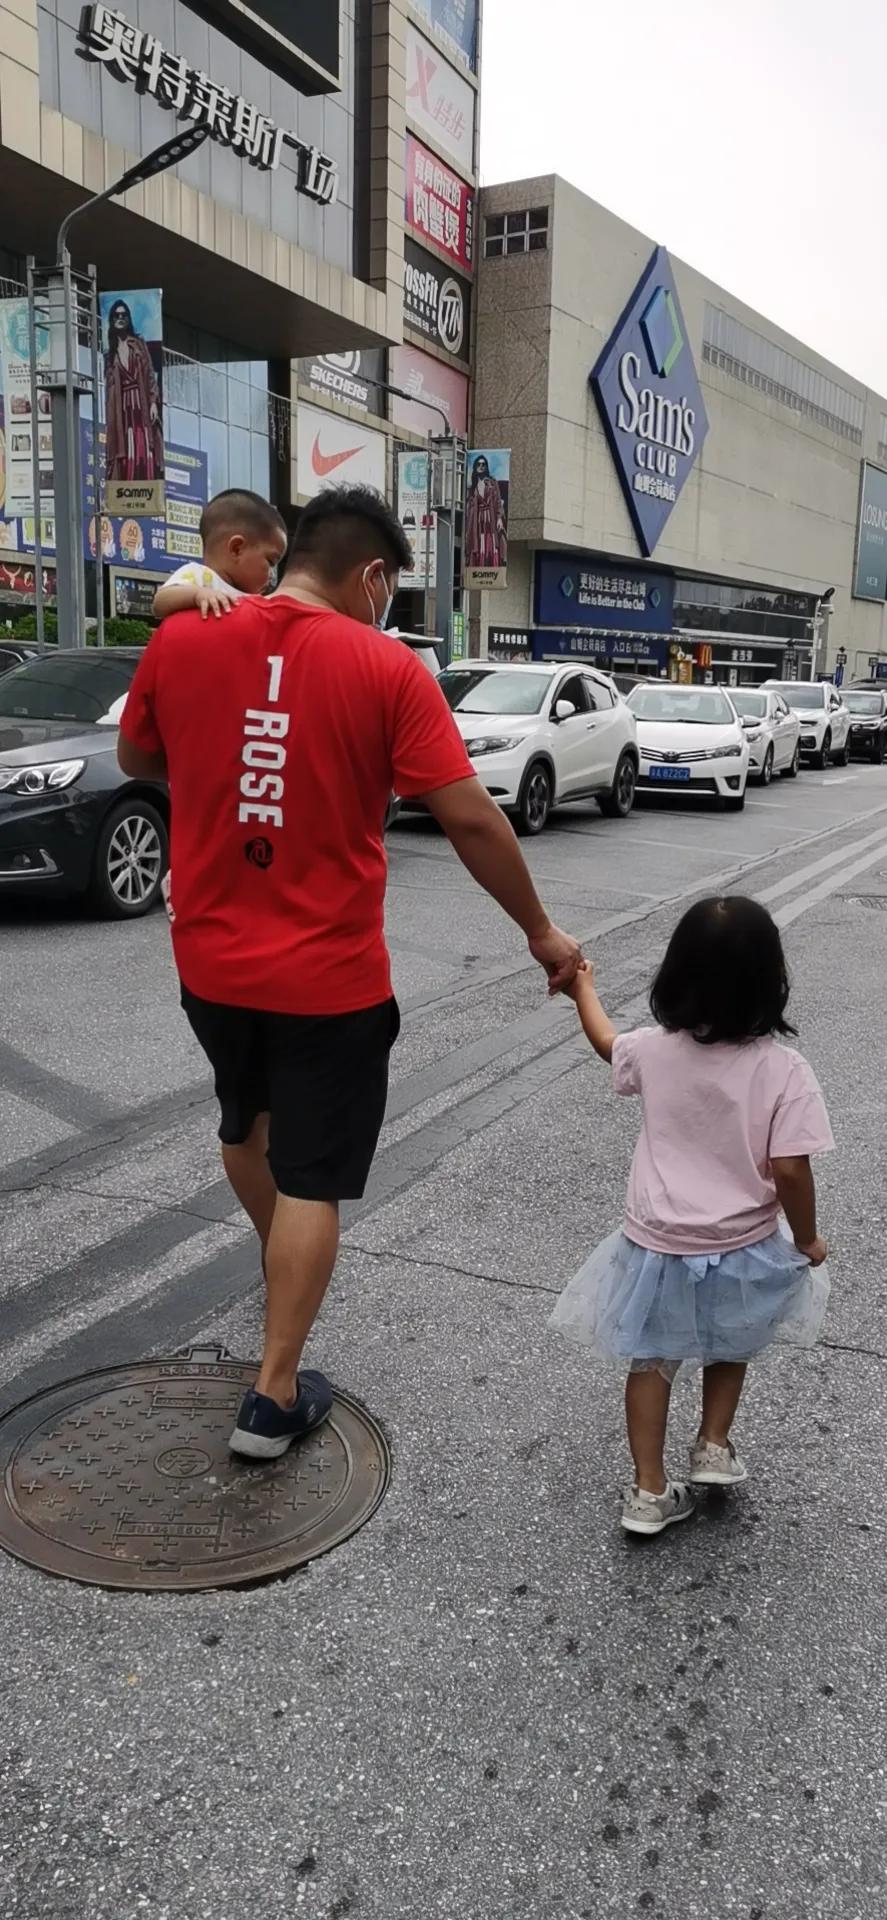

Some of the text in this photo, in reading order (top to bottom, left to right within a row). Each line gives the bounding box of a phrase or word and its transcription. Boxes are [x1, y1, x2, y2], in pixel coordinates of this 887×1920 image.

[78, 3, 339, 204] 奥特莱斯广场
[310, 364, 369, 401] SKECHERS
[618, 351, 695, 457] Sam's
[635, 442, 677, 478] CLUB
[267, 656, 284, 702] 1
[238, 709, 290, 828] ROSE
